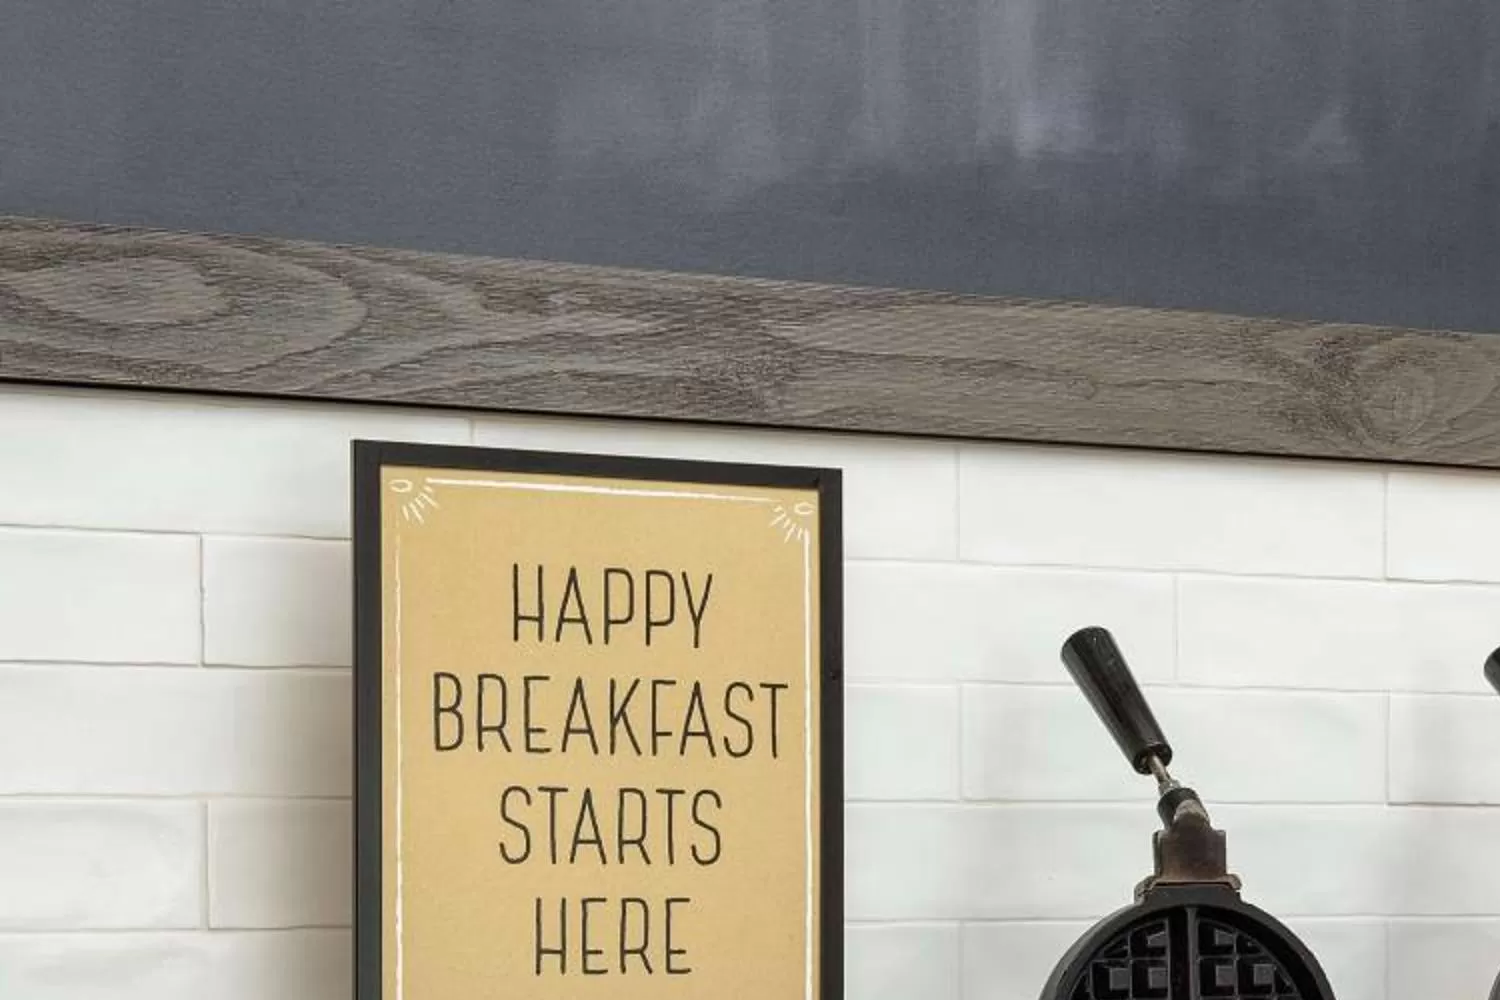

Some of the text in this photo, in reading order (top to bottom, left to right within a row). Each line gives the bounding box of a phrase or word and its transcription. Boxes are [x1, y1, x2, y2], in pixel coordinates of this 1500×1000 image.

[511, 563, 713, 647] HAPPY
[433, 671, 789, 759] BREAKFAST
[498, 785, 723, 866] STARTS
[533, 896, 693, 976] HERE
